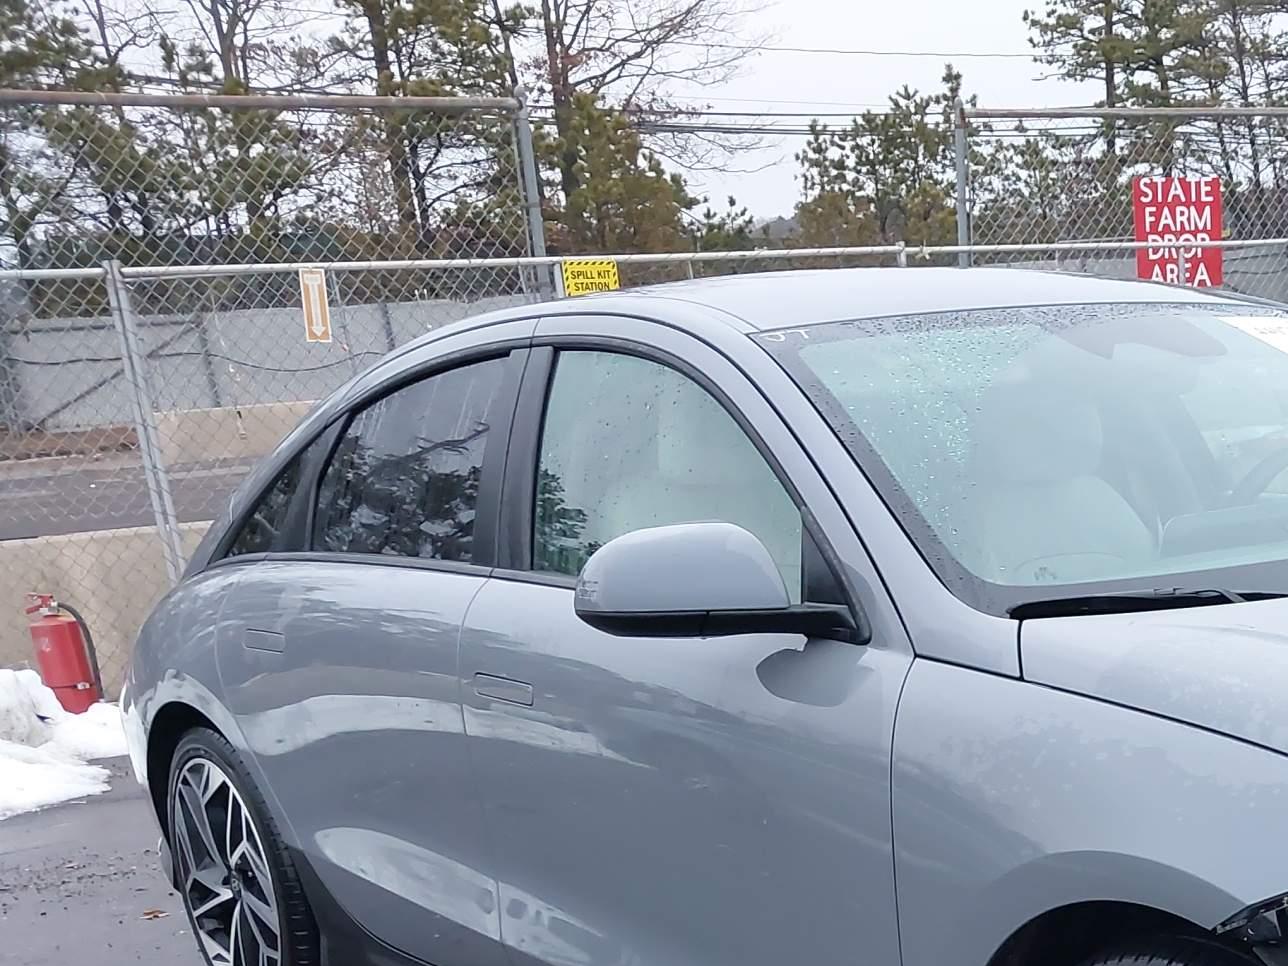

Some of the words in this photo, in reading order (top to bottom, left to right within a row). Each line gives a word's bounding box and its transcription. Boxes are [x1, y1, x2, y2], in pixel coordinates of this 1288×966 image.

[1139, 178, 1214, 202] STATE
[1144, 205, 1212, 232] FARM
[1147, 233, 1210, 260] DROP
[570, 270, 595, 279] SPILL
[597, 270, 611, 279] KIT
[574, 282, 610, 291] STATION
